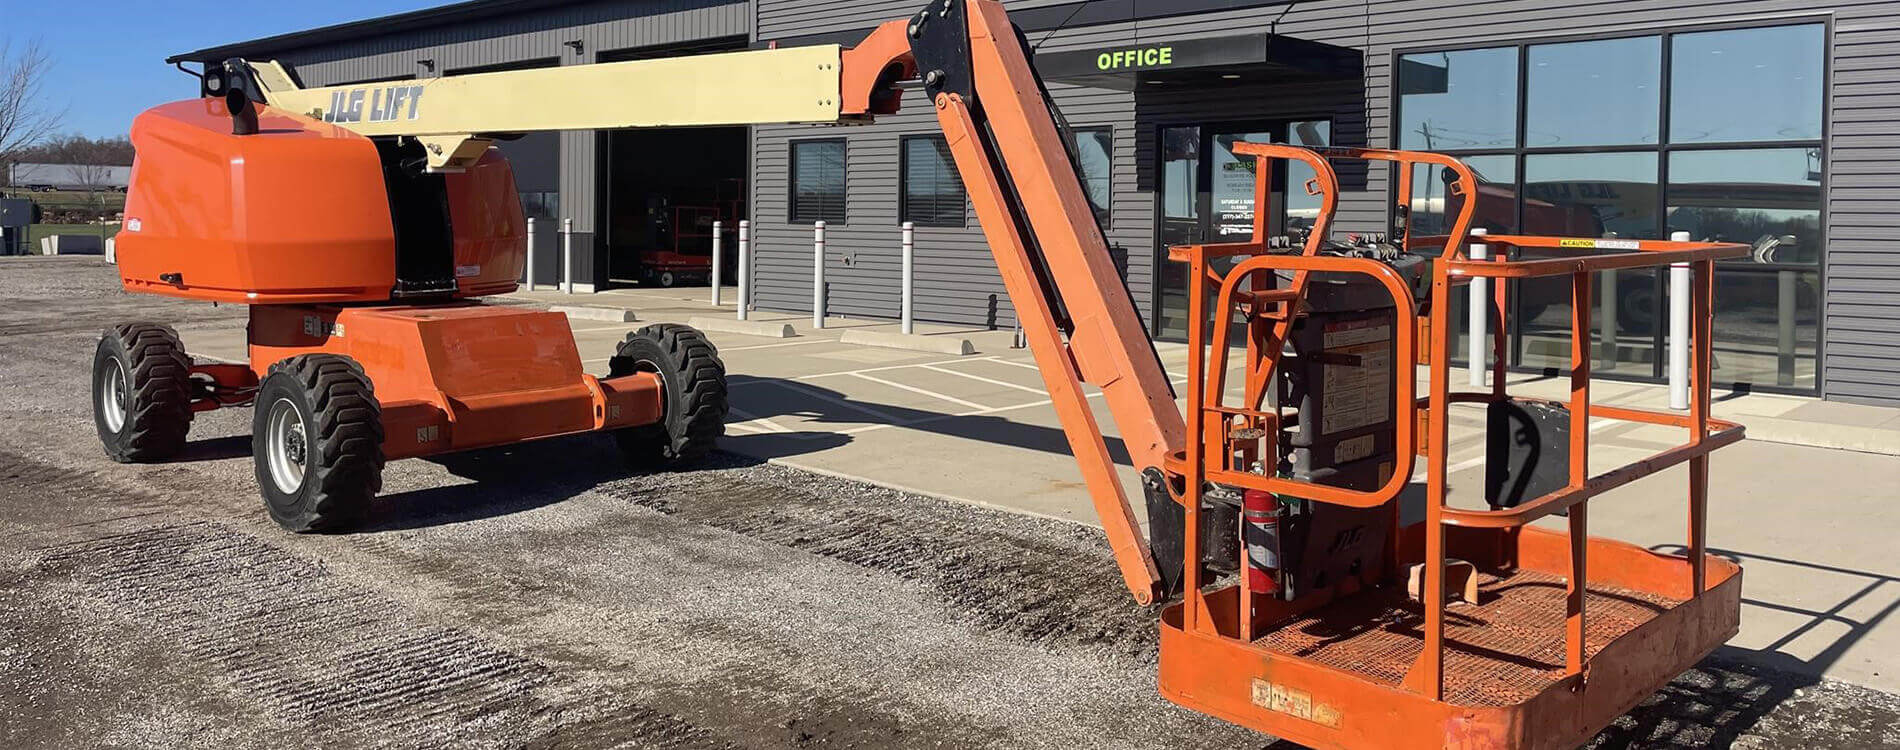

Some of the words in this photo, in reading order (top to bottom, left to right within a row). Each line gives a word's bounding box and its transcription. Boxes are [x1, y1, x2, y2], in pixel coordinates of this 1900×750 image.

[1097, 47, 1172, 70] OFFICE
[323, 89, 366, 123] JLG
[368, 85, 424, 122] LIFT
